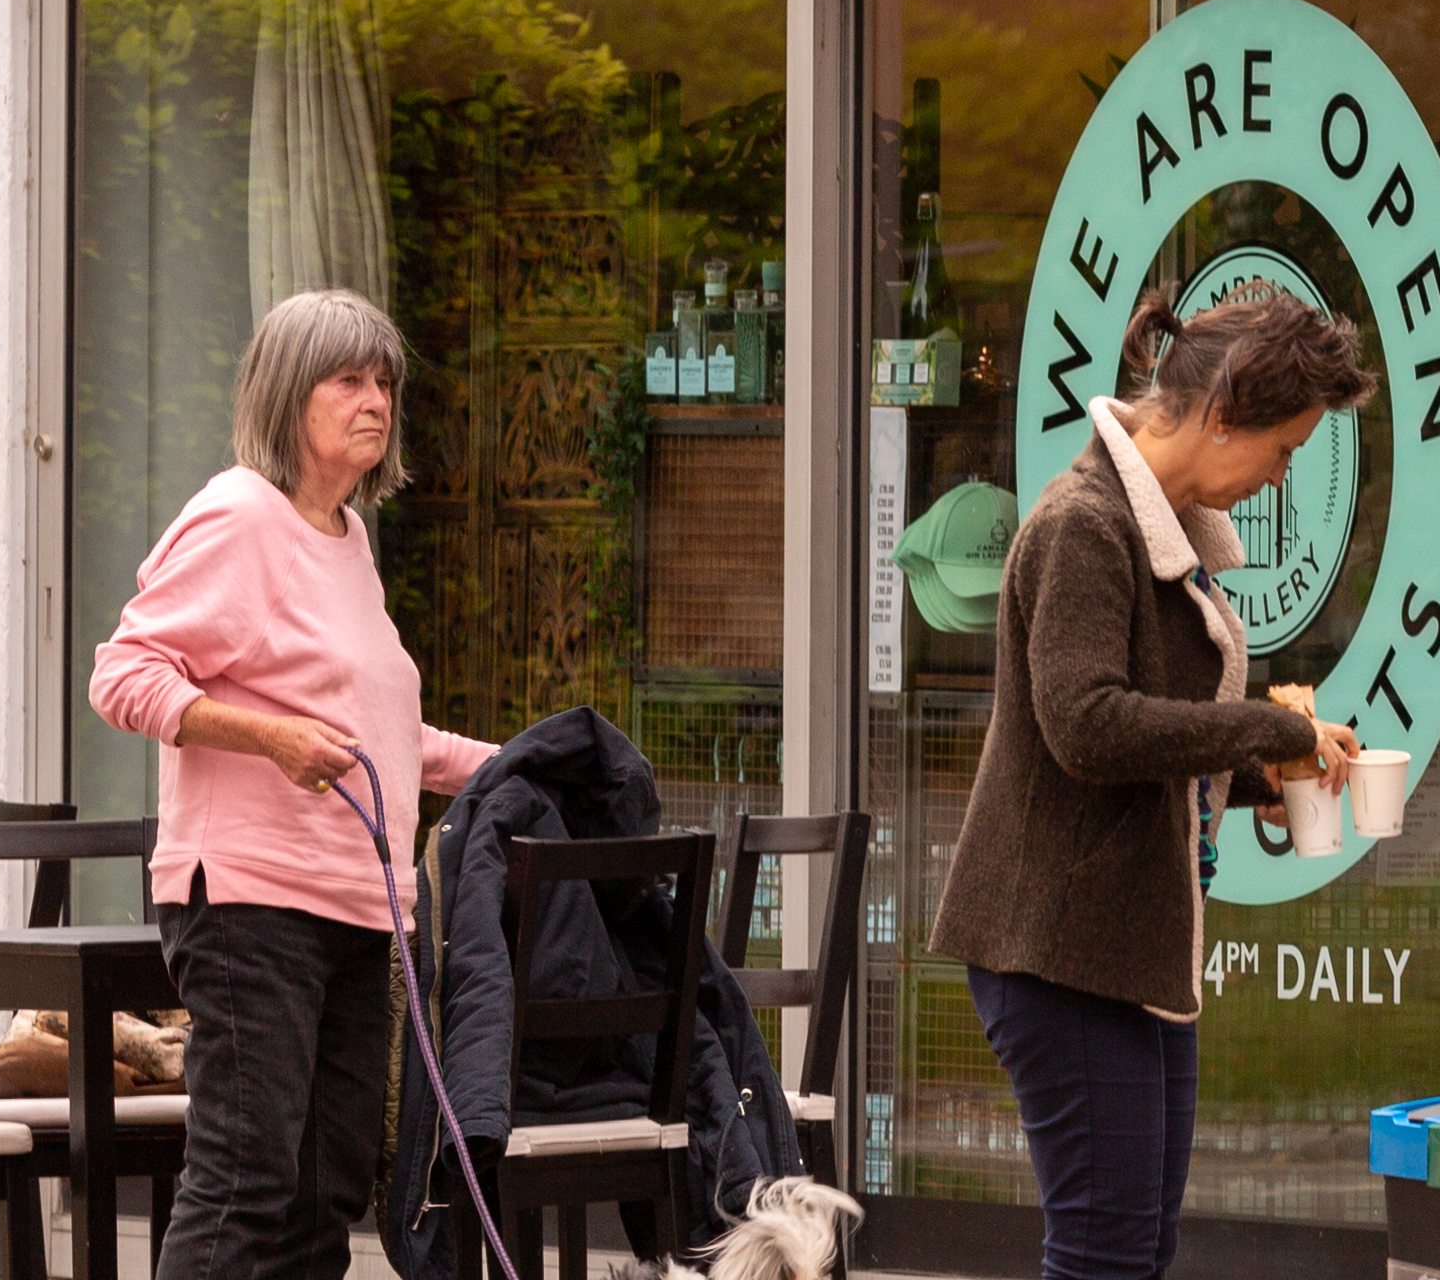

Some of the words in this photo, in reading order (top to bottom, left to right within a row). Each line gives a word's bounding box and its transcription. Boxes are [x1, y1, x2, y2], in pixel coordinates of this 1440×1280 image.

[1041, 217, 1120, 434] WE
[1136, 49, 1272, 205] ARE
[1212, 541, 1321, 628] TILLERY
[1277, 943, 1412, 1005] DAILY
